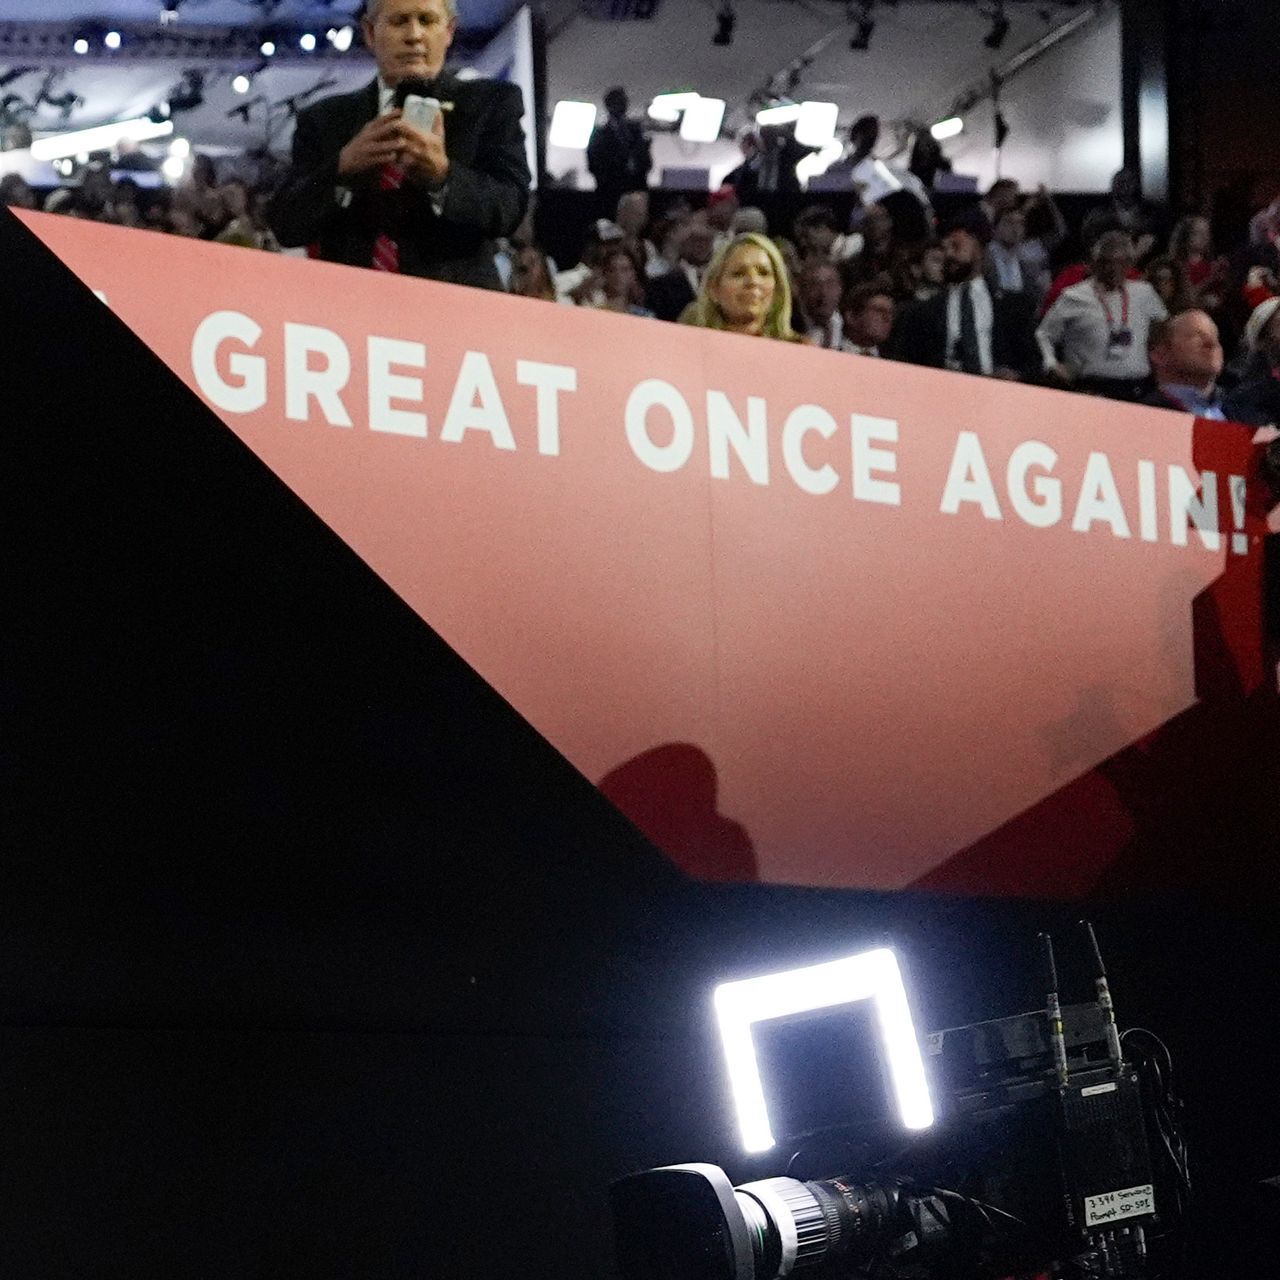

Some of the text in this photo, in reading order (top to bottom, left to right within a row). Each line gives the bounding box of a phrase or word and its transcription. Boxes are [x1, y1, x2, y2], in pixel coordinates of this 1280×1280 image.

[191, 310, 1249, 555] GREAT ONCE AGAIN!
